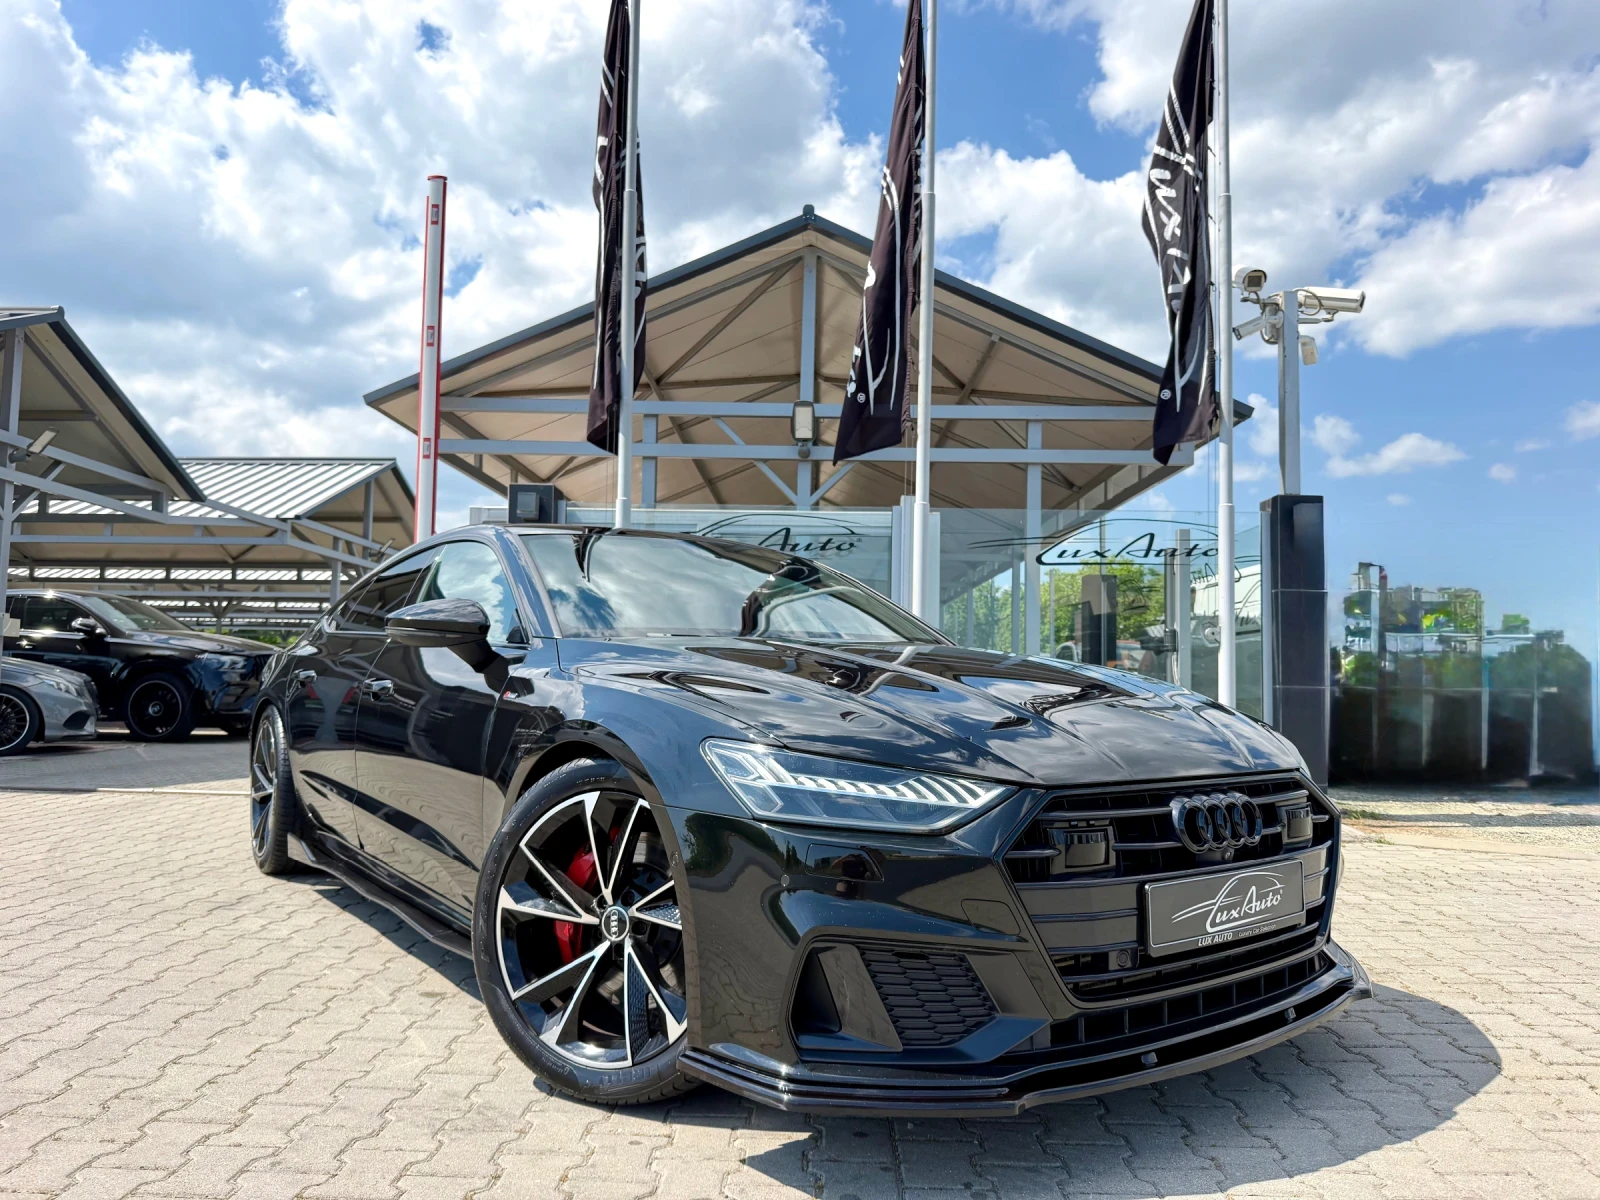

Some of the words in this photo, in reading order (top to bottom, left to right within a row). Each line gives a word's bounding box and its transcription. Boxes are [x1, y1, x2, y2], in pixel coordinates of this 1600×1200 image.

[758, 527, 858, 551] Auto
[1240, 886, 1281, 915] Auto
[1198, 936, 1213, 947] LUX
[1213, 932, 1233, 944] AUTO
[1238, 930, 1252, 938] Luxury
